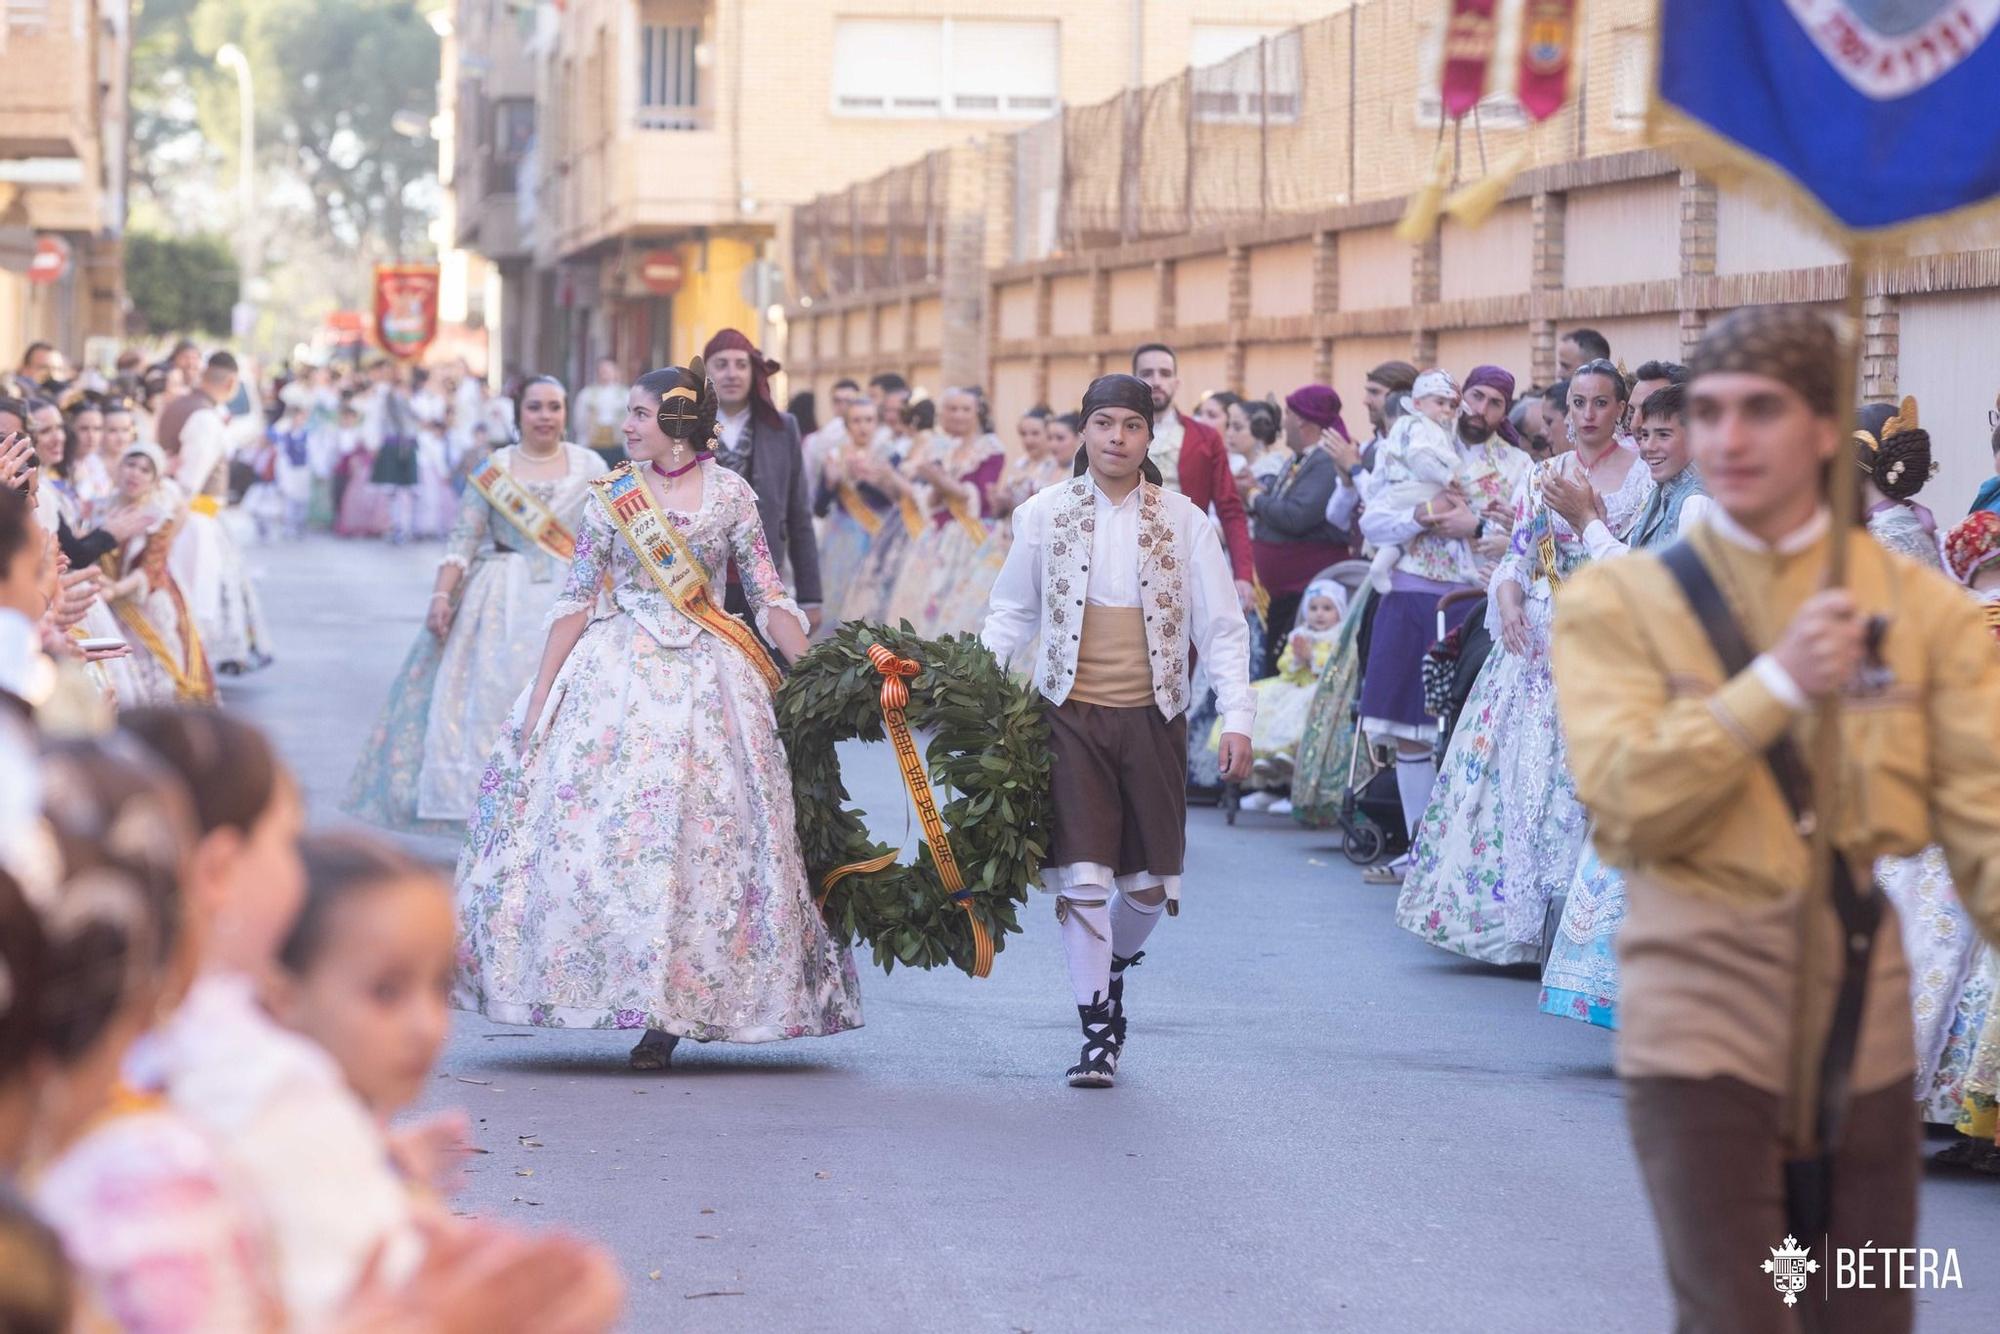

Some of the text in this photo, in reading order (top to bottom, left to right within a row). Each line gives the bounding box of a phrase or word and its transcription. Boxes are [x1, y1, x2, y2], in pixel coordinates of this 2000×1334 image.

[634, 516, 656, 539] 2023
[887, 708, 917, 756] GRAN
[917, 797, 938, 823] DEL
[929, 834, 953, 864] SUR
